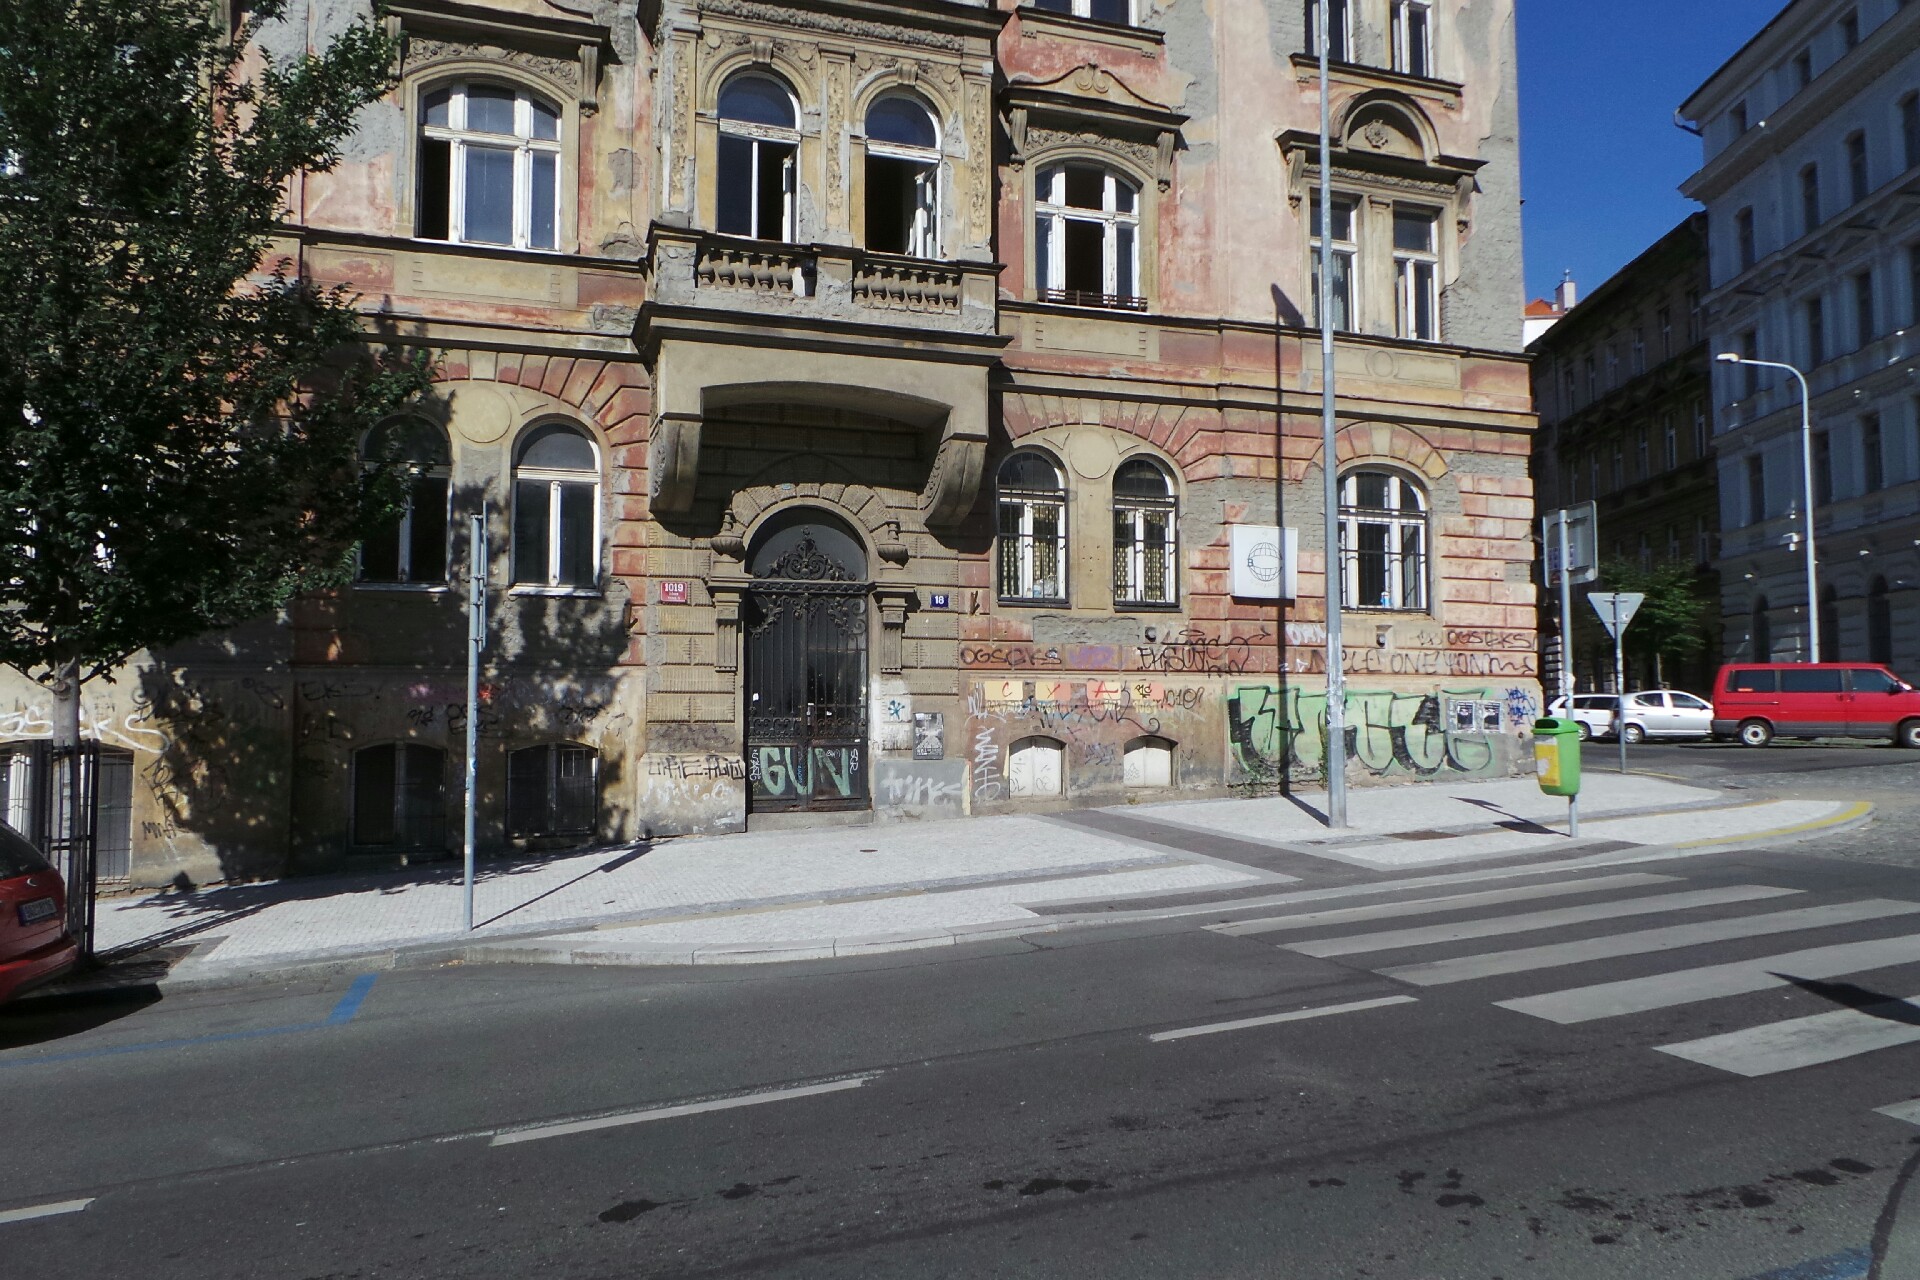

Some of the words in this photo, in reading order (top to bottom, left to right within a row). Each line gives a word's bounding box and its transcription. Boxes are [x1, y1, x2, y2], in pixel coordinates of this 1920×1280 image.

[664, 583, 684, 592] 1019
[934, 595, 945, 605] 18
[760, 746, 851, 796] GUN
